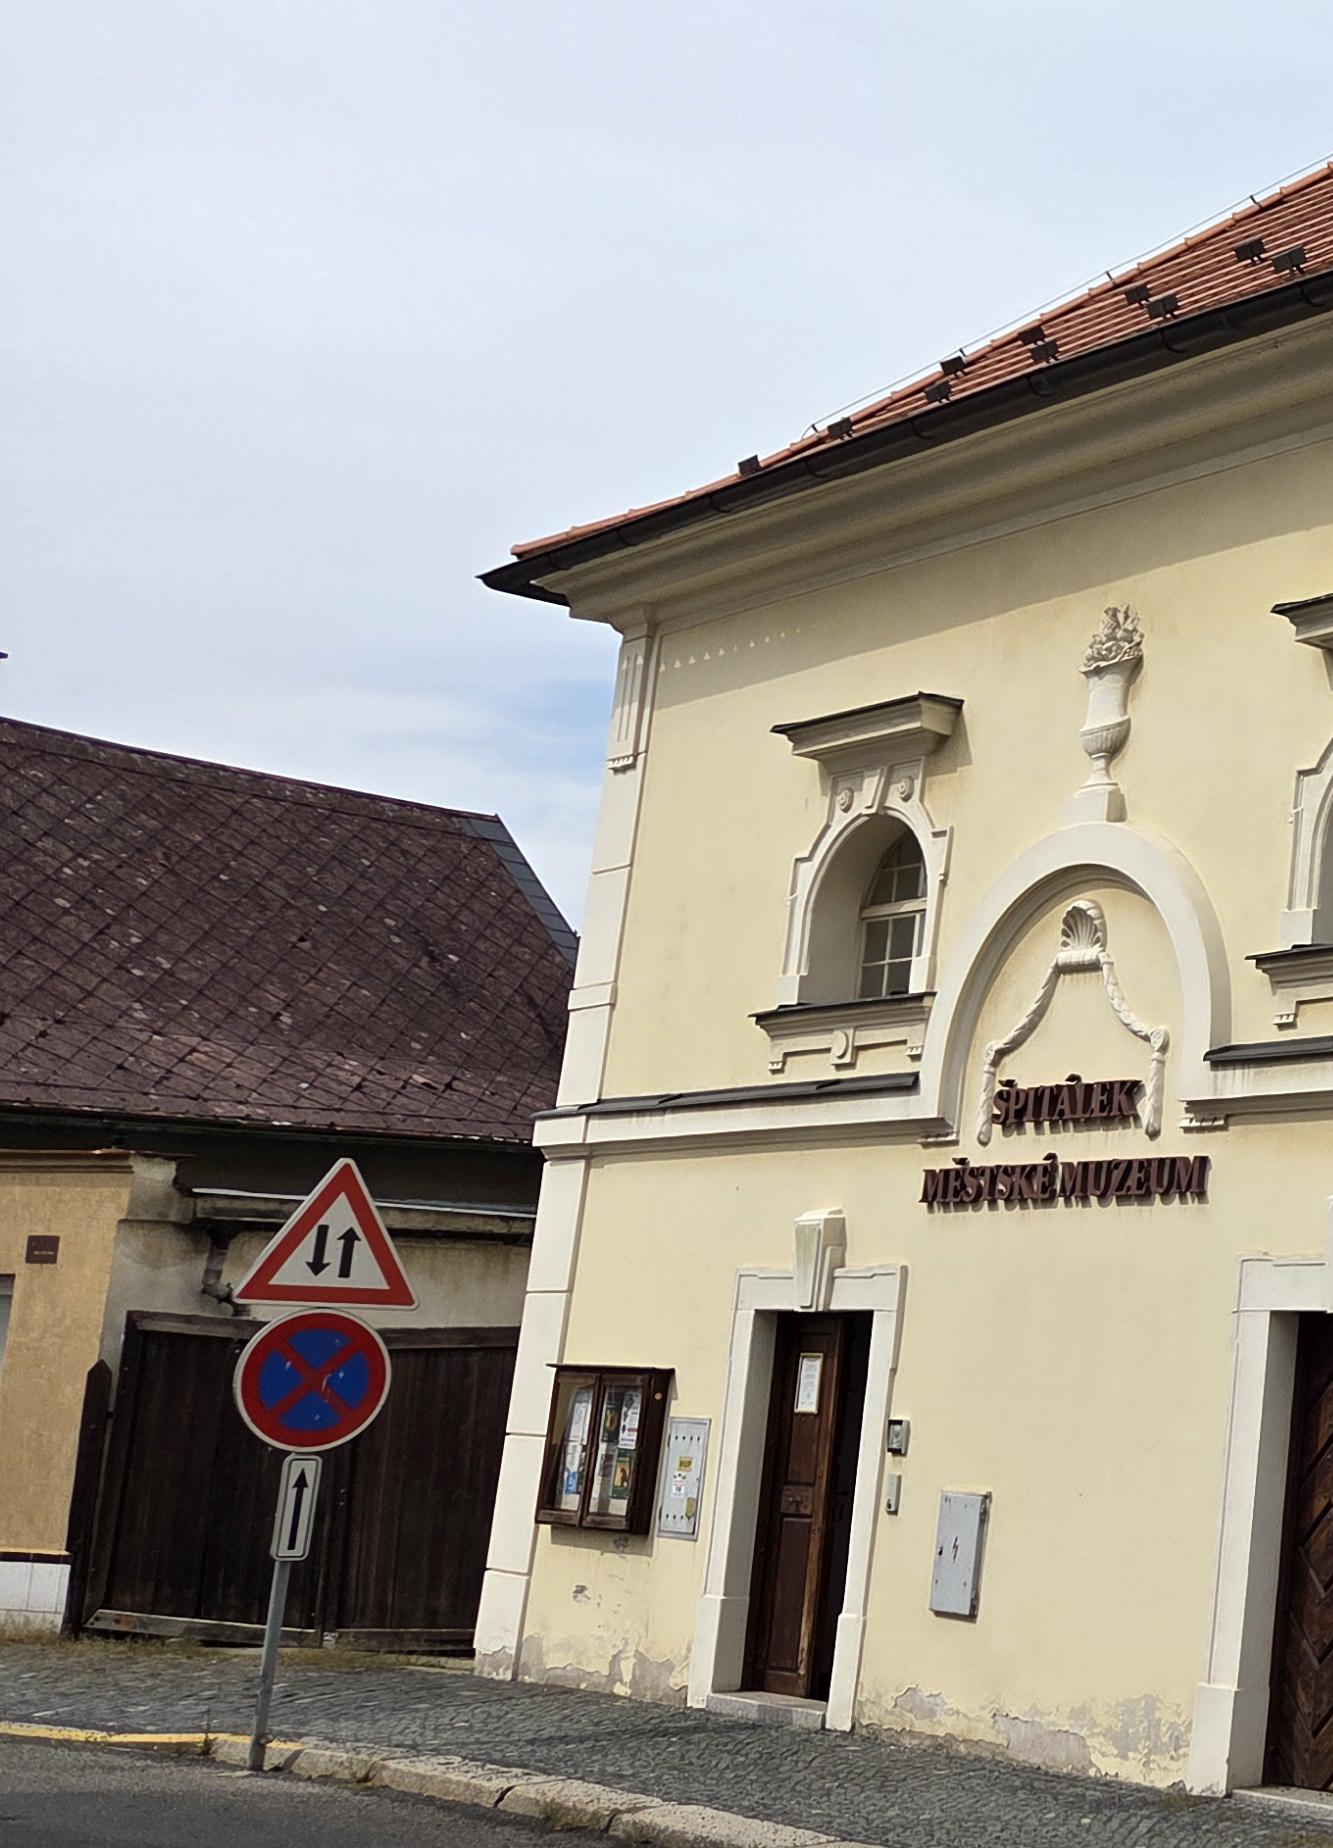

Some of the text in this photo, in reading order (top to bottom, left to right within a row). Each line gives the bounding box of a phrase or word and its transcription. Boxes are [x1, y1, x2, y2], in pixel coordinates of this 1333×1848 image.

[991, 1073, 1143, 1125] ŠPITÁLEK
[919, 1152, 1210, 1203] MĚSTSKÉ MUZEUM
